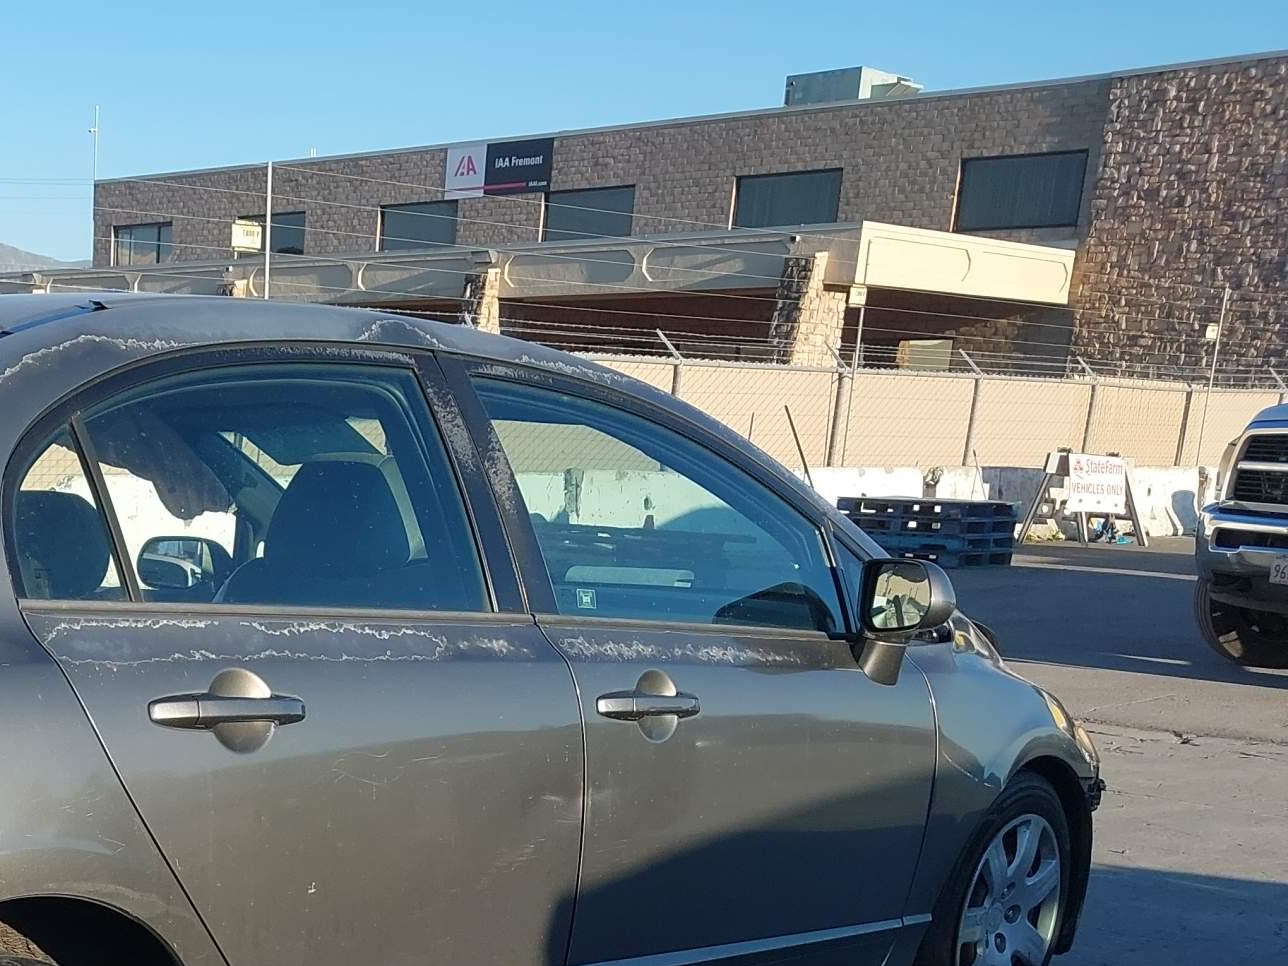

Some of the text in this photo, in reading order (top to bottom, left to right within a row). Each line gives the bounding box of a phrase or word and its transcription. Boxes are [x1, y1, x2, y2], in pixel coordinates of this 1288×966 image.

[494, 155, 544, 169] IAA Fremont
[1072, 482, 1123, 496] VEHICLES ONLY
[1274, 564, 1288, 580] 96
